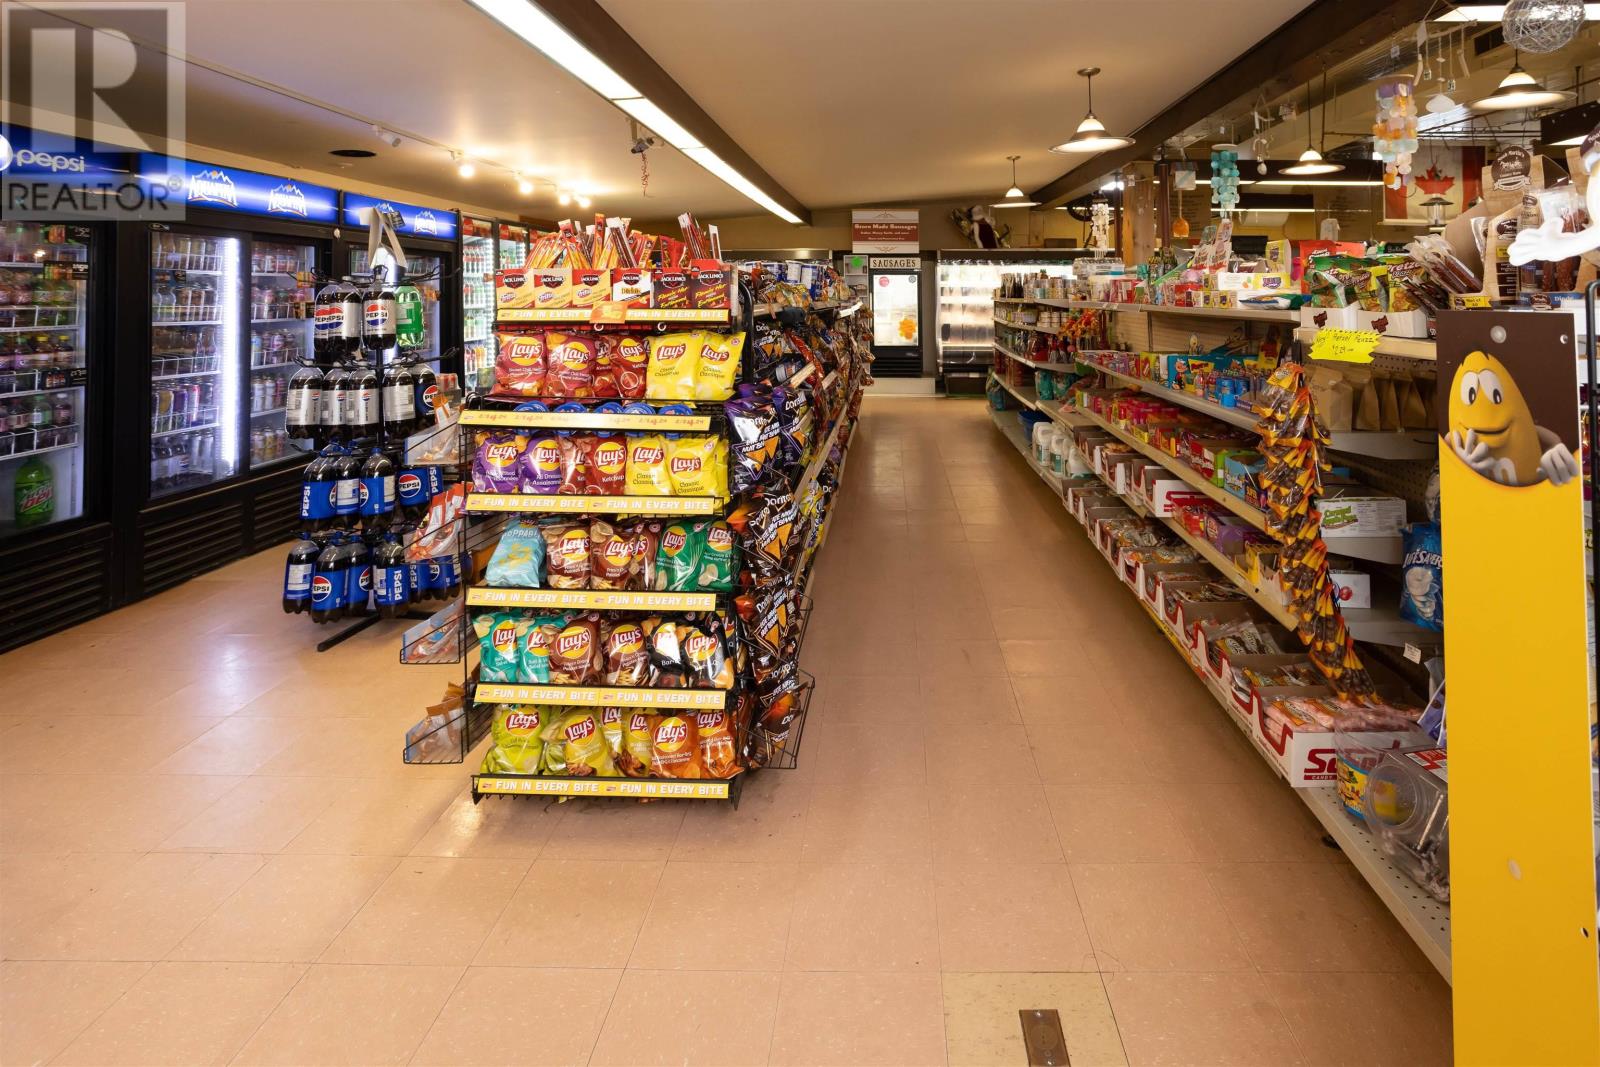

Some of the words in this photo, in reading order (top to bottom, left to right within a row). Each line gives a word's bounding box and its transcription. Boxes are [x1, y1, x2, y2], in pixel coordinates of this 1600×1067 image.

[16, 149, 85, 172] pepsi
[872, 259, 916, 268] SAUSAGES
[301, 486, 311, 517] PEPSI
[483, 498, 505, 506] FUN
[510, 498, 519, 506] IN
[523, 499, 557, 507] EVERY
[560, 499, 585, 508] BITE
[606, 500, 627, 509] FUN
[632, 500, 642, 509] IN
[645, 501, 680, 510] EVERY
[684, 501, 709, 510] BITE
[394, 569, 403, 600] PEPSI
[484, 592, 506, 601] FUN
[510, 592, 521, 601] IN
[524, 593, 558, 602] EVERY
[561, 594, 587, 603] BITE
[607, 595, 630, 605] FUN
[633, 596, 644, 605] IN
[647, 596, 682, 606] EVERY
[687, 597, 711, 606] BITE
[492, 689, 514, 698] FUN
[518, 690, 529, 698] IN
[532, 690, 566, 699] EVERY
[570, 691, 595, 701] BITE
[616, 693, 639, 702] FUN
[642, 693, 654, 702] IN
[656, 693, 692, 703] EVERY
[695, 695, 721, 705] BITE
[495, 781, 517, 790] FUN
[521, 782, 532, 791] IN
[535, 782, 569, 791] EVERY
[574, 783, 599, 792] BITE
[620, 783, 642, 793] FUN
[646, 784, 657, 794] IN
[660, 784, 695, 794] EVERY
[698, 785, 724, 795] BITE
